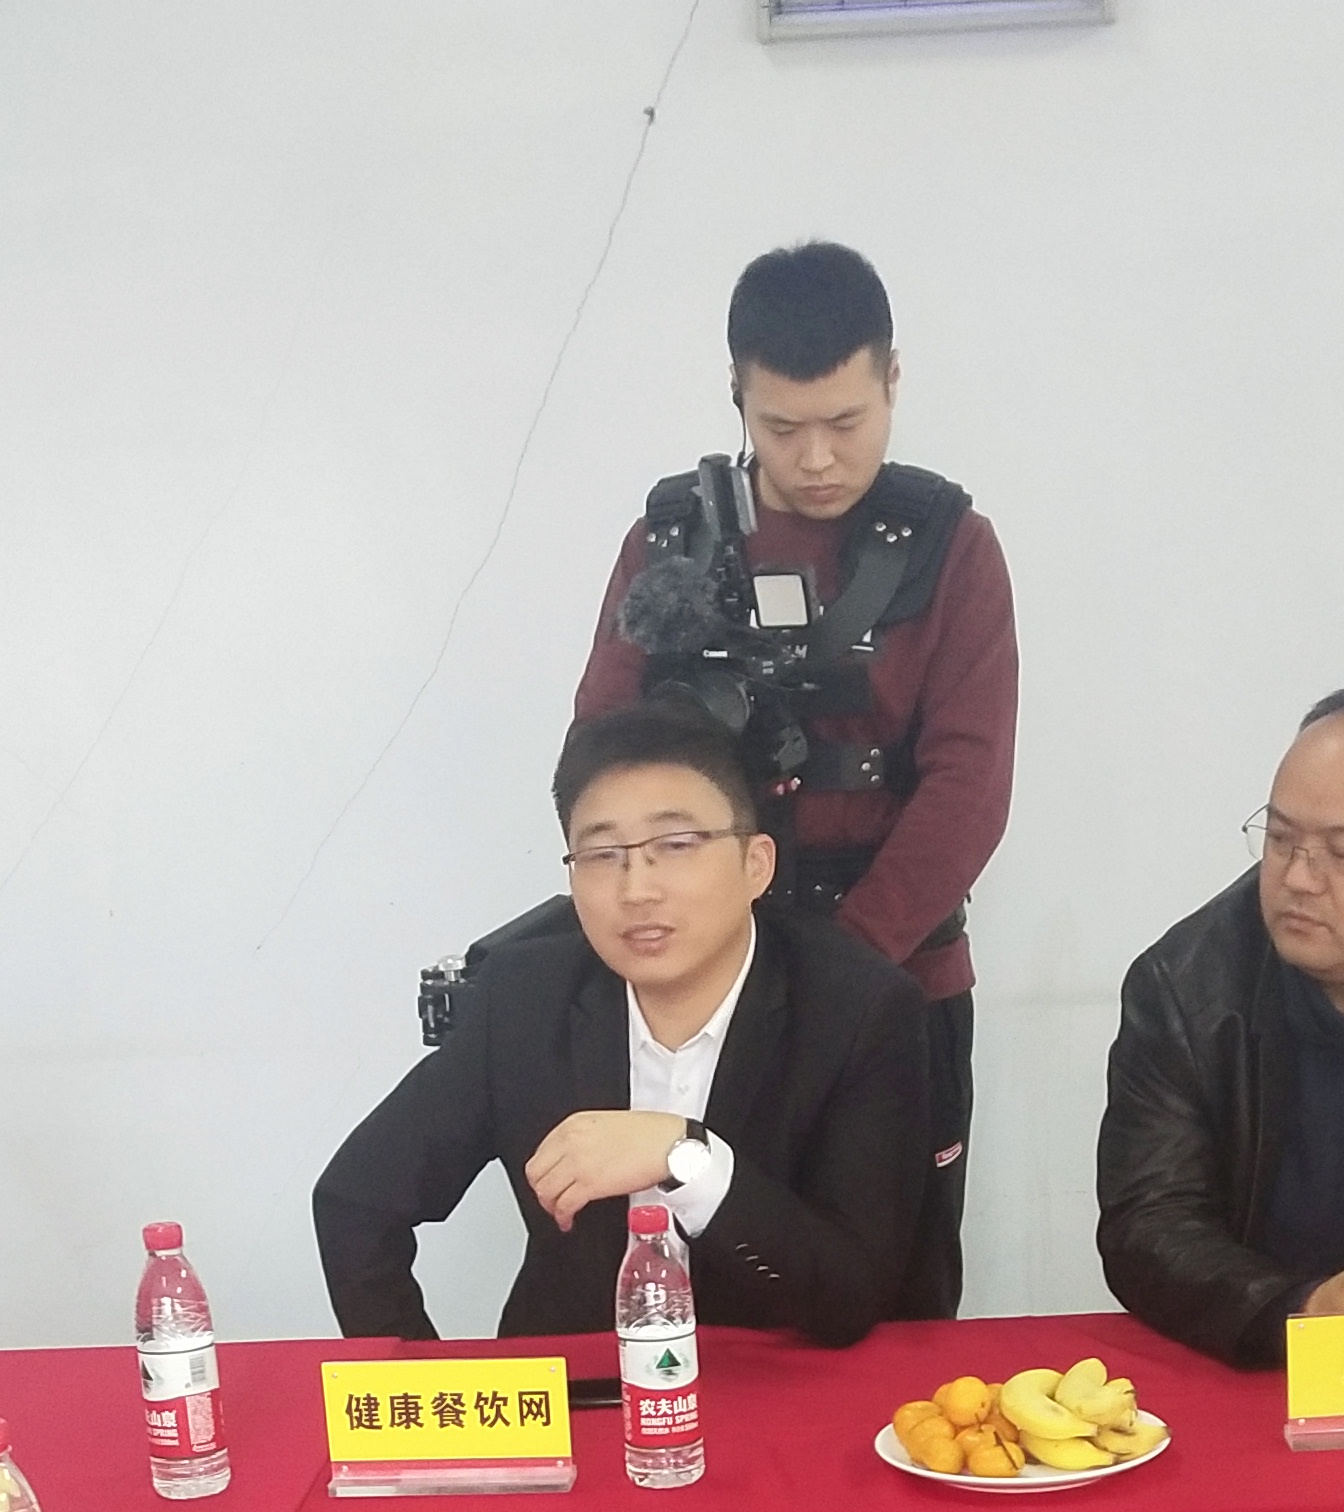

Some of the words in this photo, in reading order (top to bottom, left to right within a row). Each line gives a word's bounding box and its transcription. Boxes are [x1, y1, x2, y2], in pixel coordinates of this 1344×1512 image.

[345, 1391, 552, 1431] 健康餐饮网
